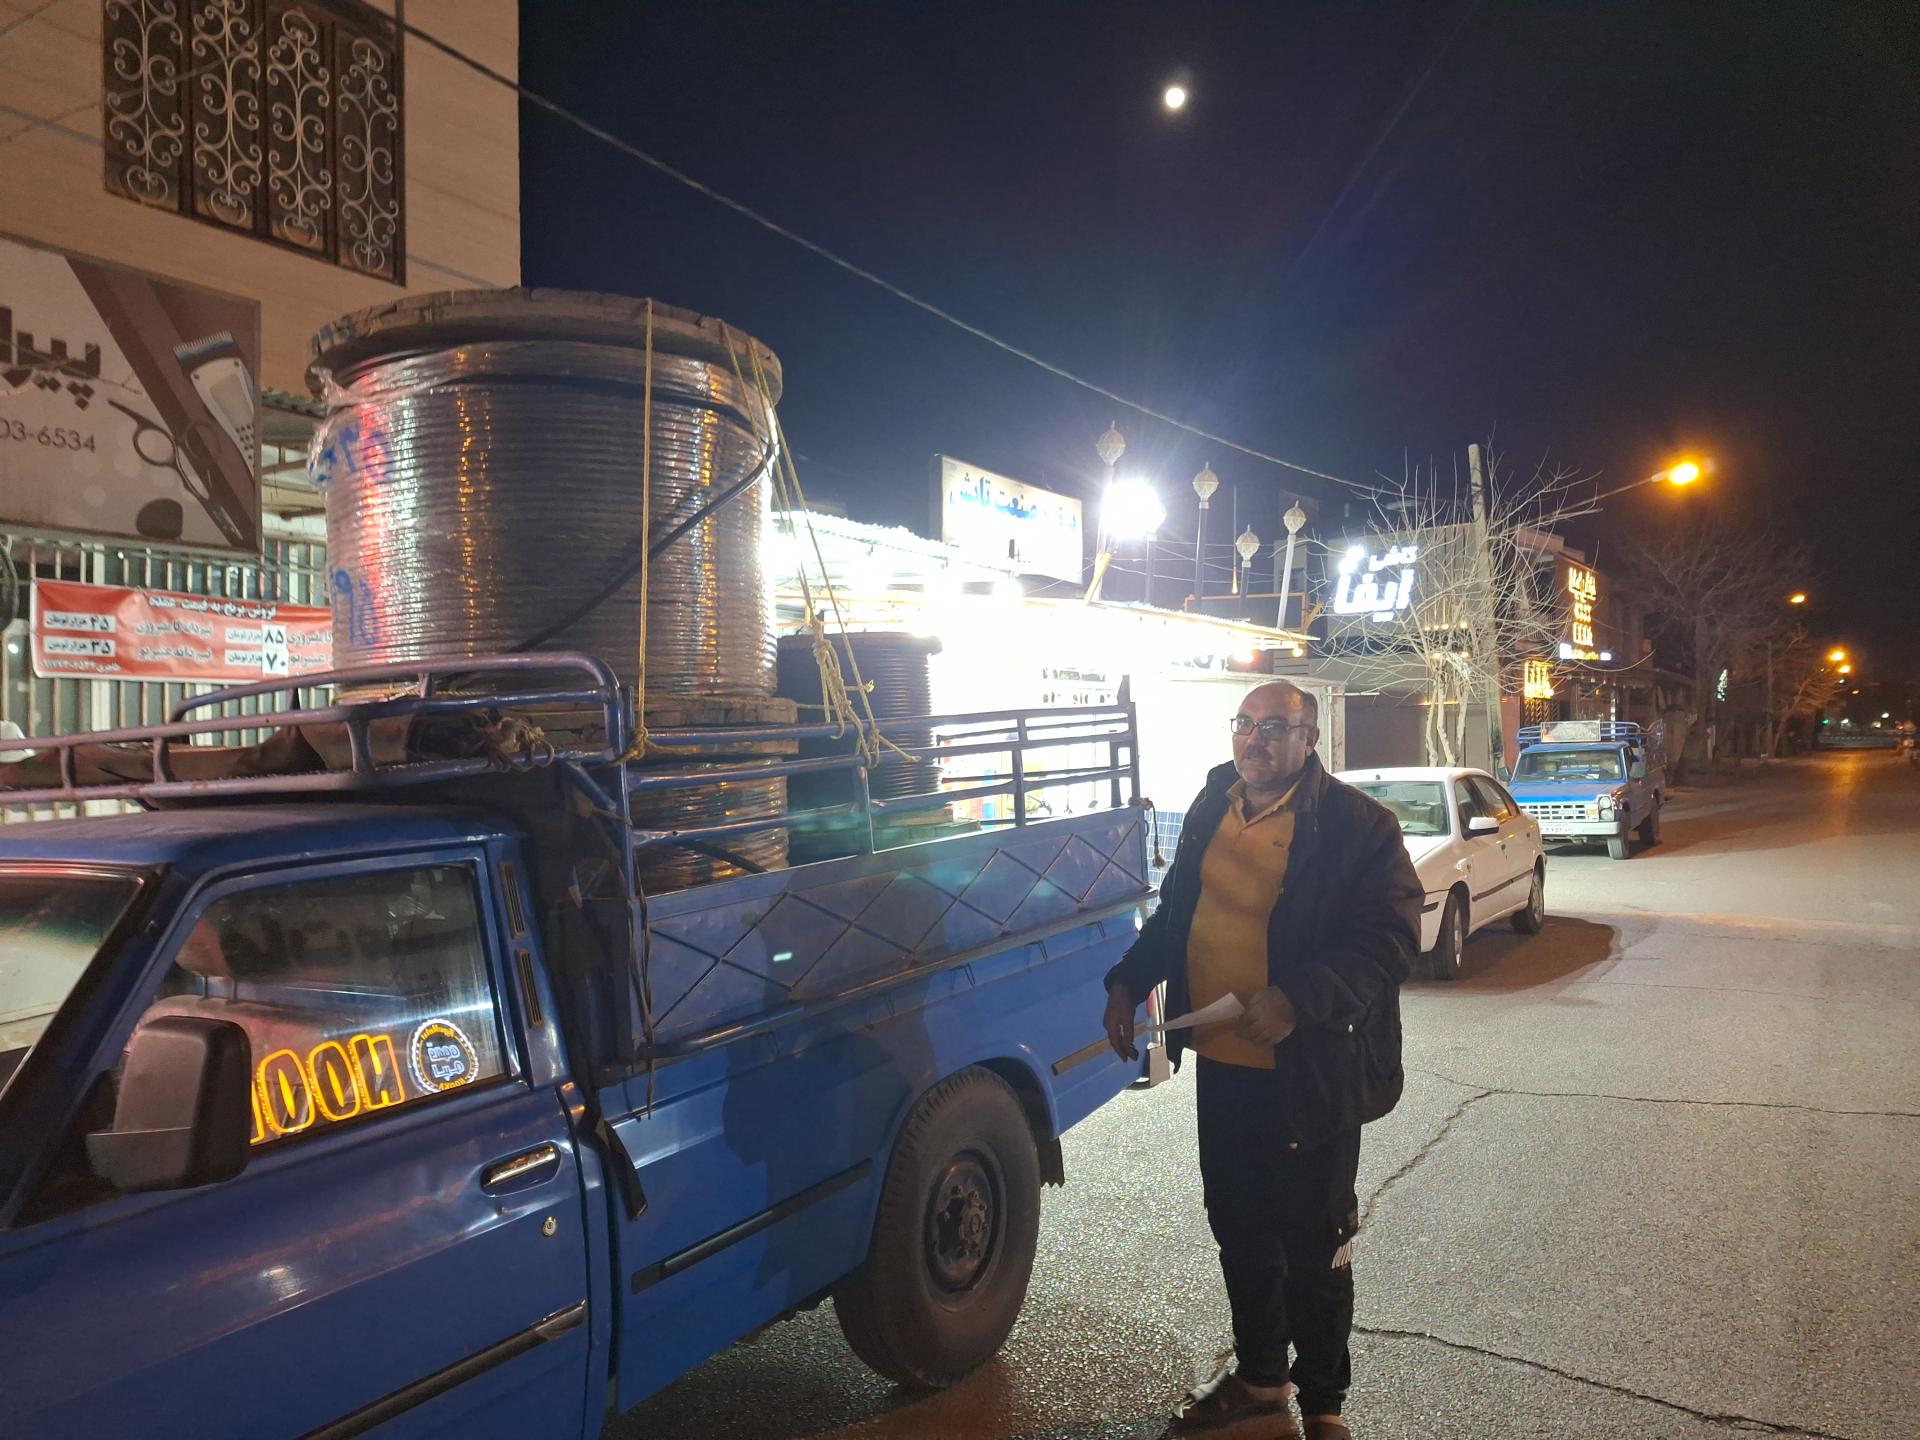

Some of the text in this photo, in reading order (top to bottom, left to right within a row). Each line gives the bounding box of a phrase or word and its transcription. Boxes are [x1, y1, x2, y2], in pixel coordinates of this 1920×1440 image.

[994, 492, 1038, 519] صنعت
[149, 595, 176, 609] عمده
[181, 599, 208, 613] قیمت
[224, 602, 245, 618] برنج
[46, 614, 68, 626] تومان
[71, 616, 88, 627] هزار
[264, 629, 285, 644] ۸۵
[71, 641, 88, 652] هزار
[265, 652, 287, 671] ۷۰
